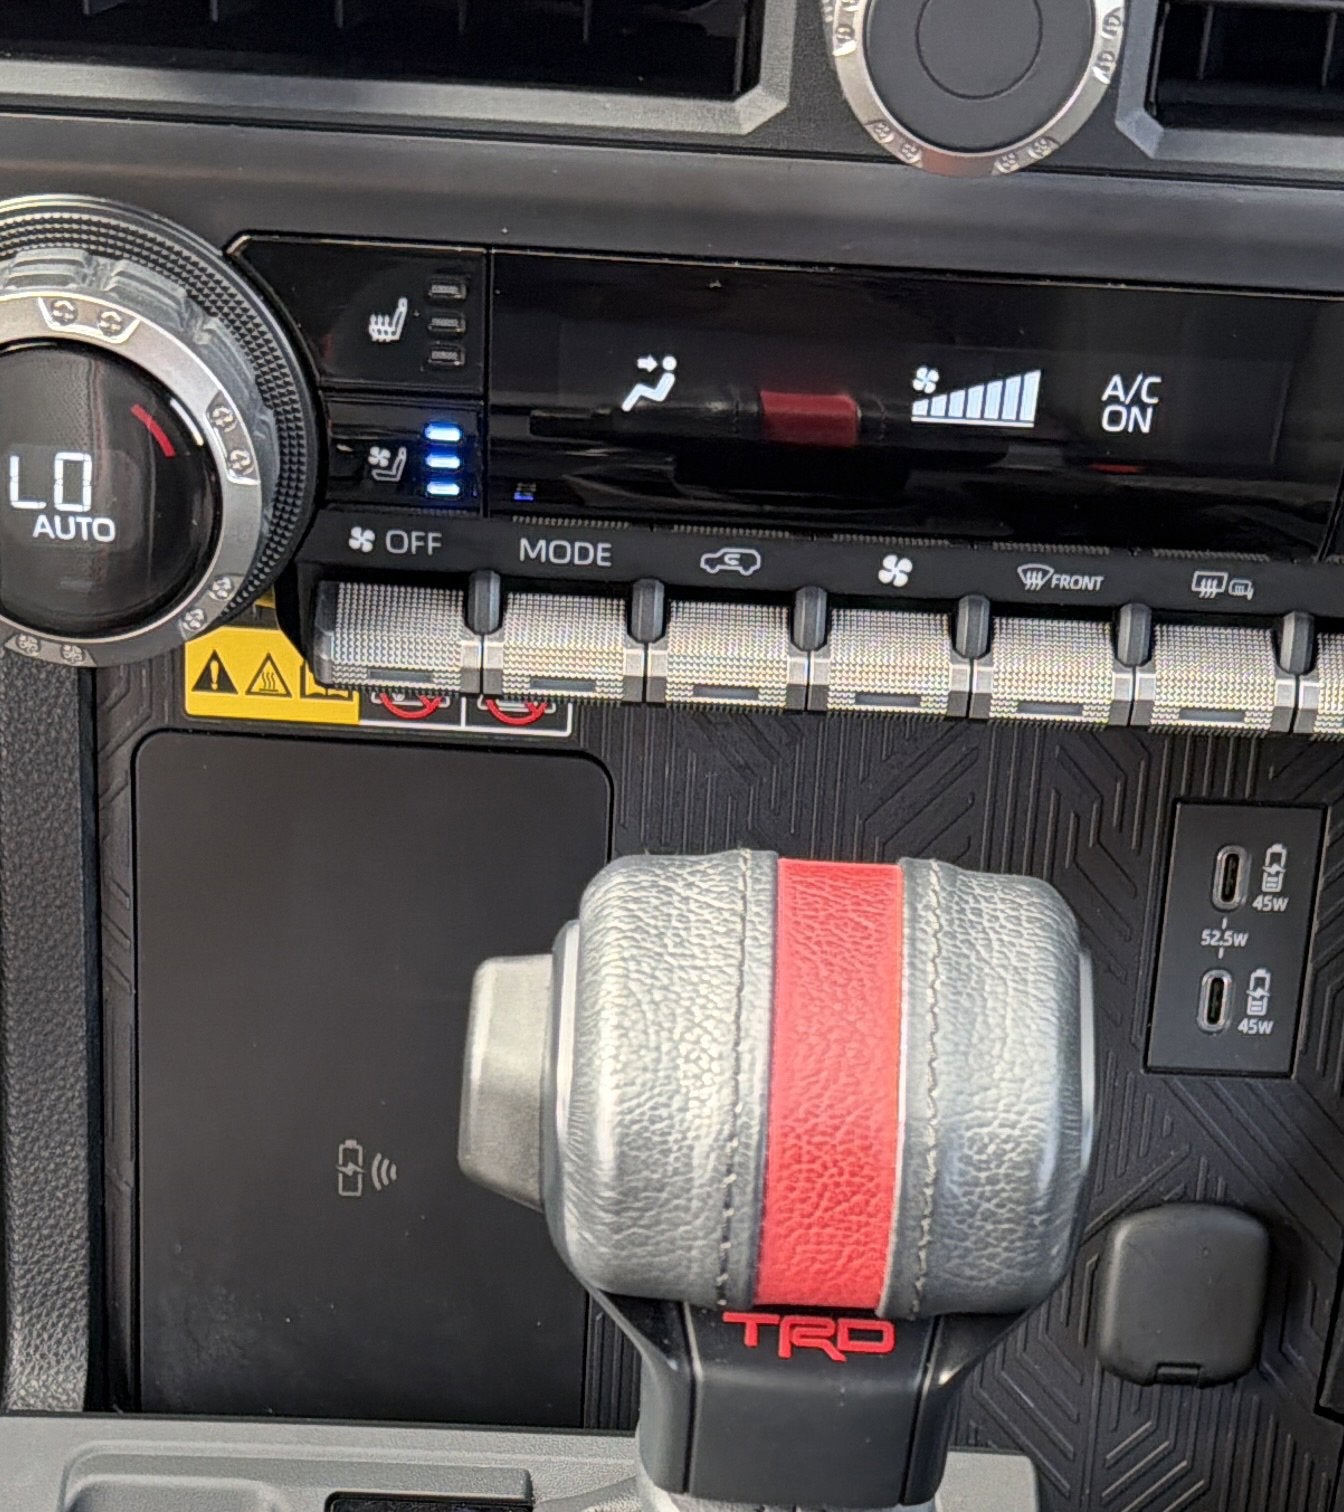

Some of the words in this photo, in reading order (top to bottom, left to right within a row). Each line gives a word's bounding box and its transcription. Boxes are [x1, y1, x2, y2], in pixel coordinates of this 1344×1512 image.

[1101, 373, 1162, 404] A/C
[1100, 406, 1154, 434] ON
[9, 451, 92, 513] LO
[32, 515, 116, 543] AUTO
[385, 530, 443, 555] OFF
[520, 538, 612, 566] MODE
[1051, 573, 1104, 591] FRONT
[1252, 895, 1289, 912] 45W
[1201, 930, 1248, 946] 52.5W
[1237, 1019, 1273, 1034] 45W
[722, 1312, 896, 1362] TRD
